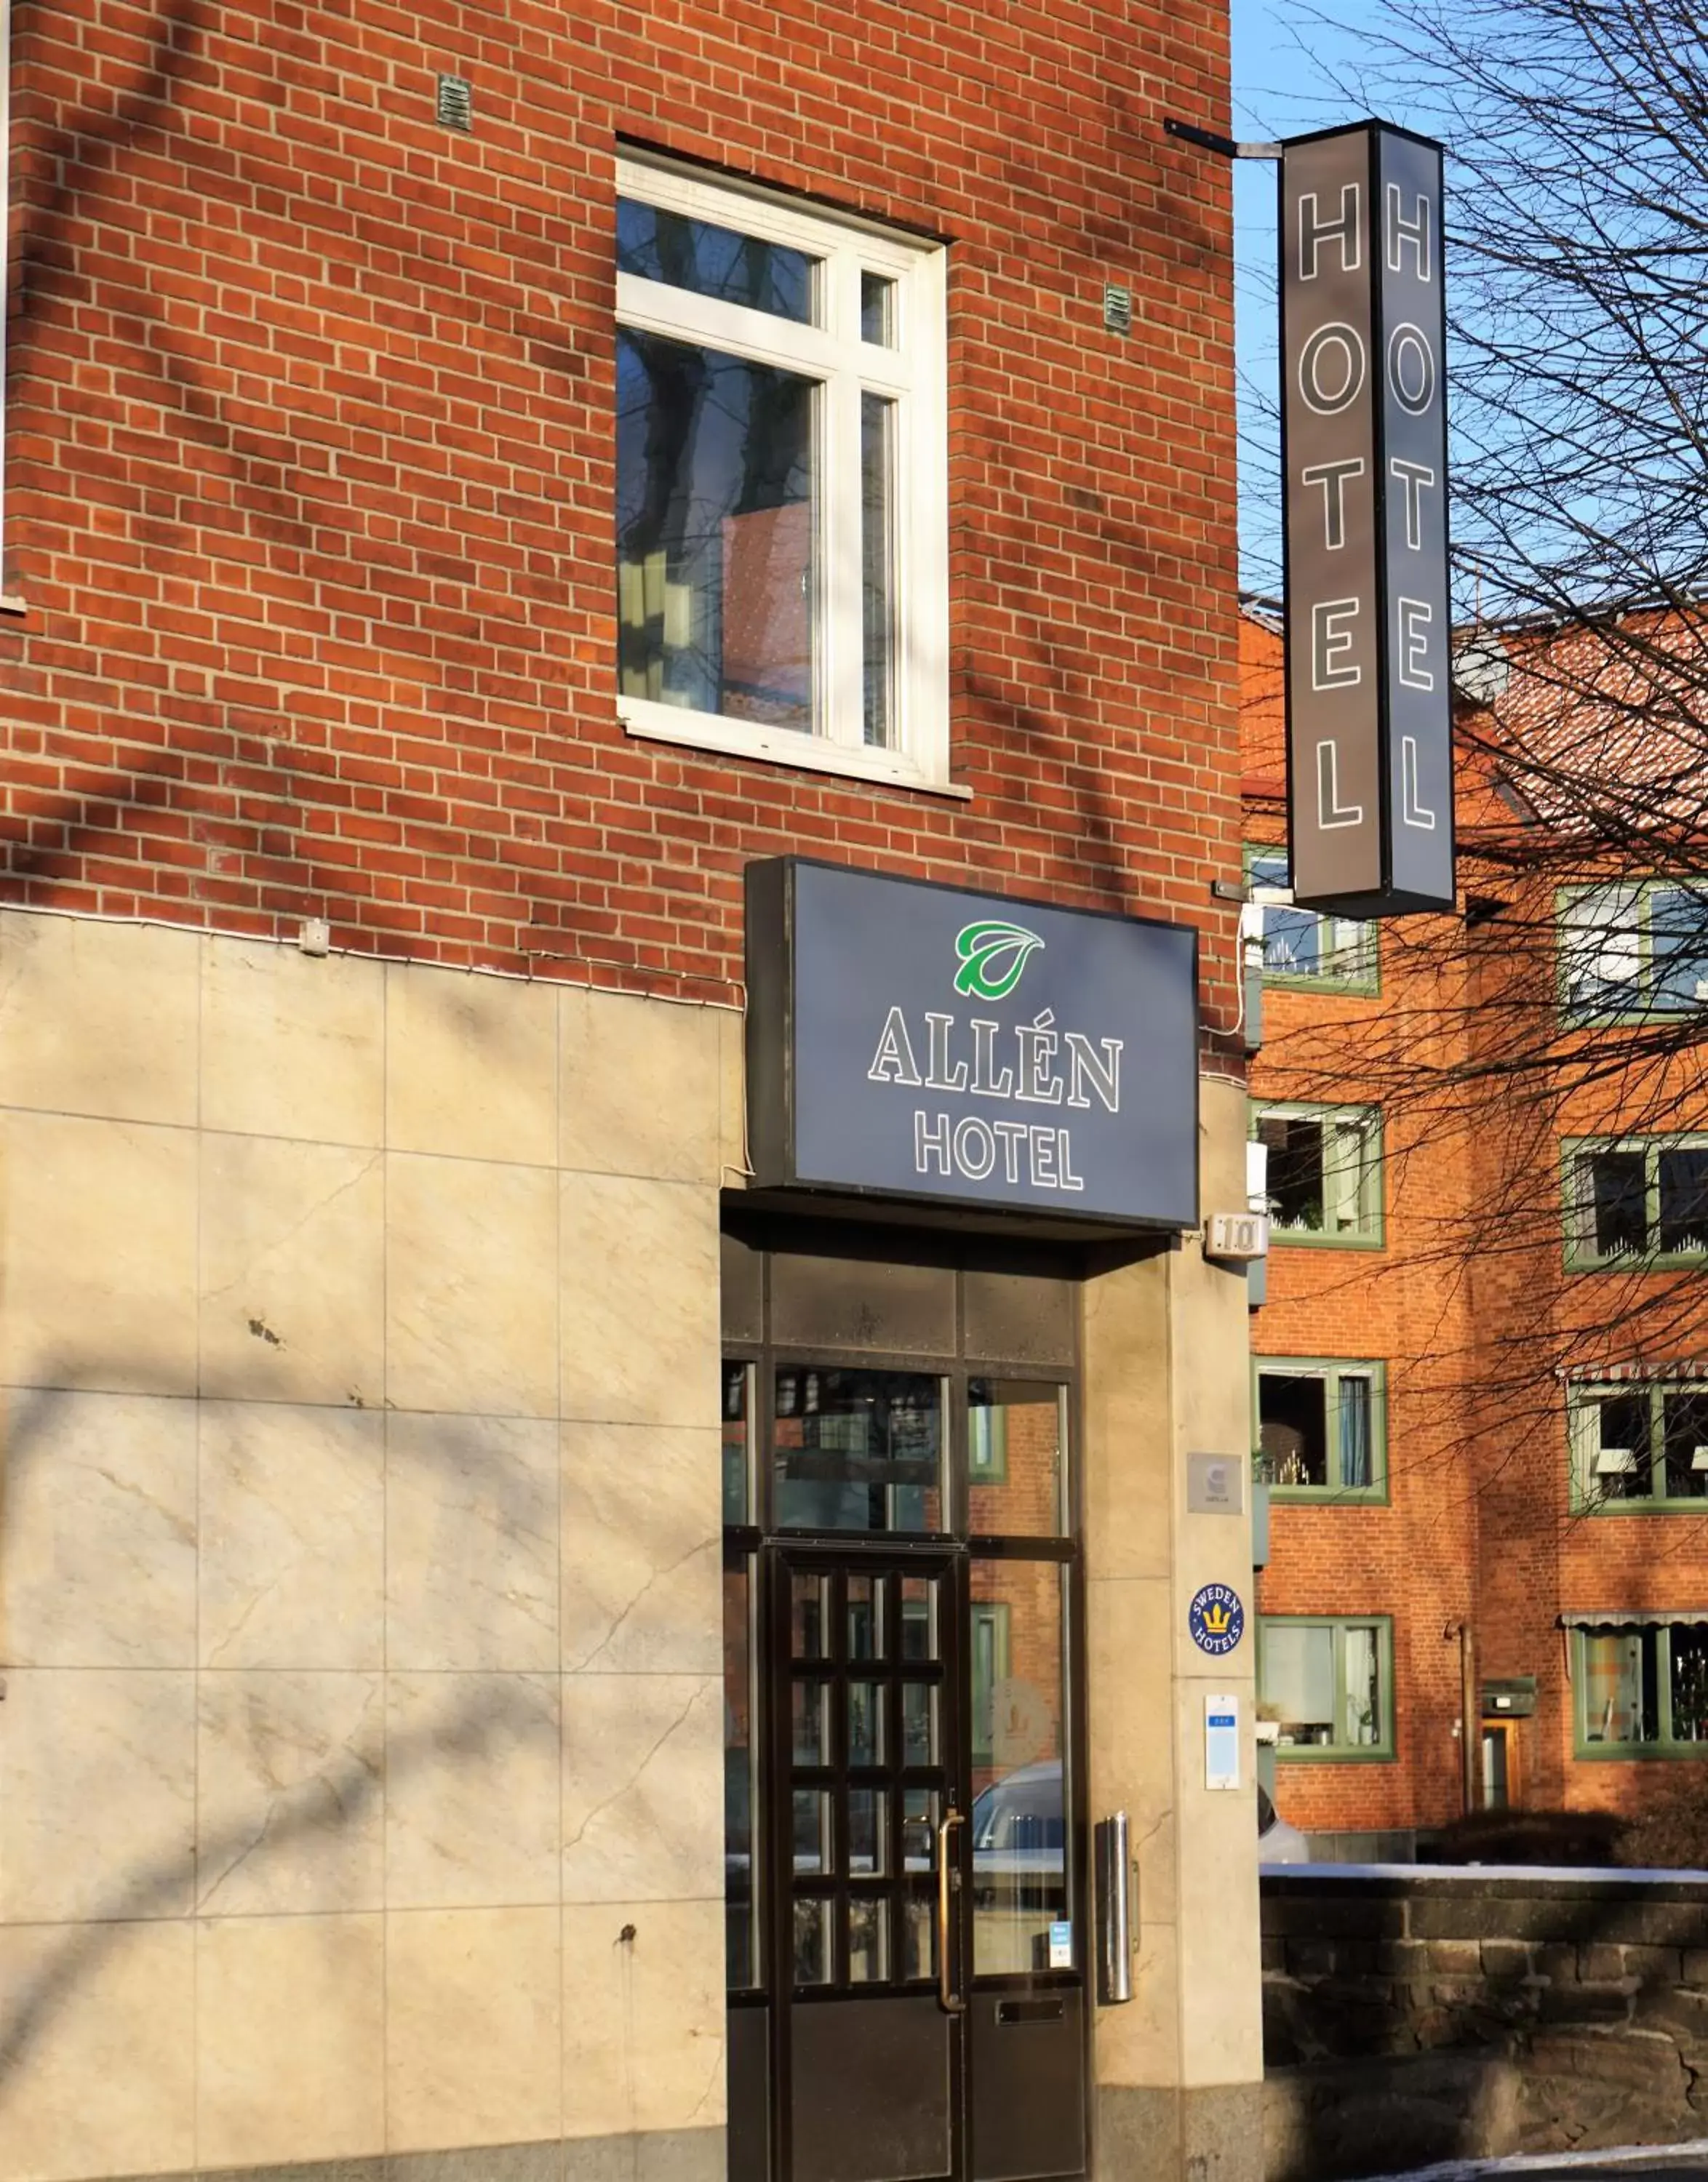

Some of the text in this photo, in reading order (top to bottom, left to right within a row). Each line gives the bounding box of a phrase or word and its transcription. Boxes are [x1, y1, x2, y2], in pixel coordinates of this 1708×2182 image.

[1298, 183, 1365, 830] HOTEL
[1386, 183, 1436, 830] HOTEL
[867, 1007, 1123, 1112] ALLÉN
[914, 1111, 1084, 1190] HOTEL
[1224, 1218, 1254, 1251] 10
[1193, 1586, 1240, 1616] SWEDEN
[1195, 1625, 1241, 1653] HOTELS
